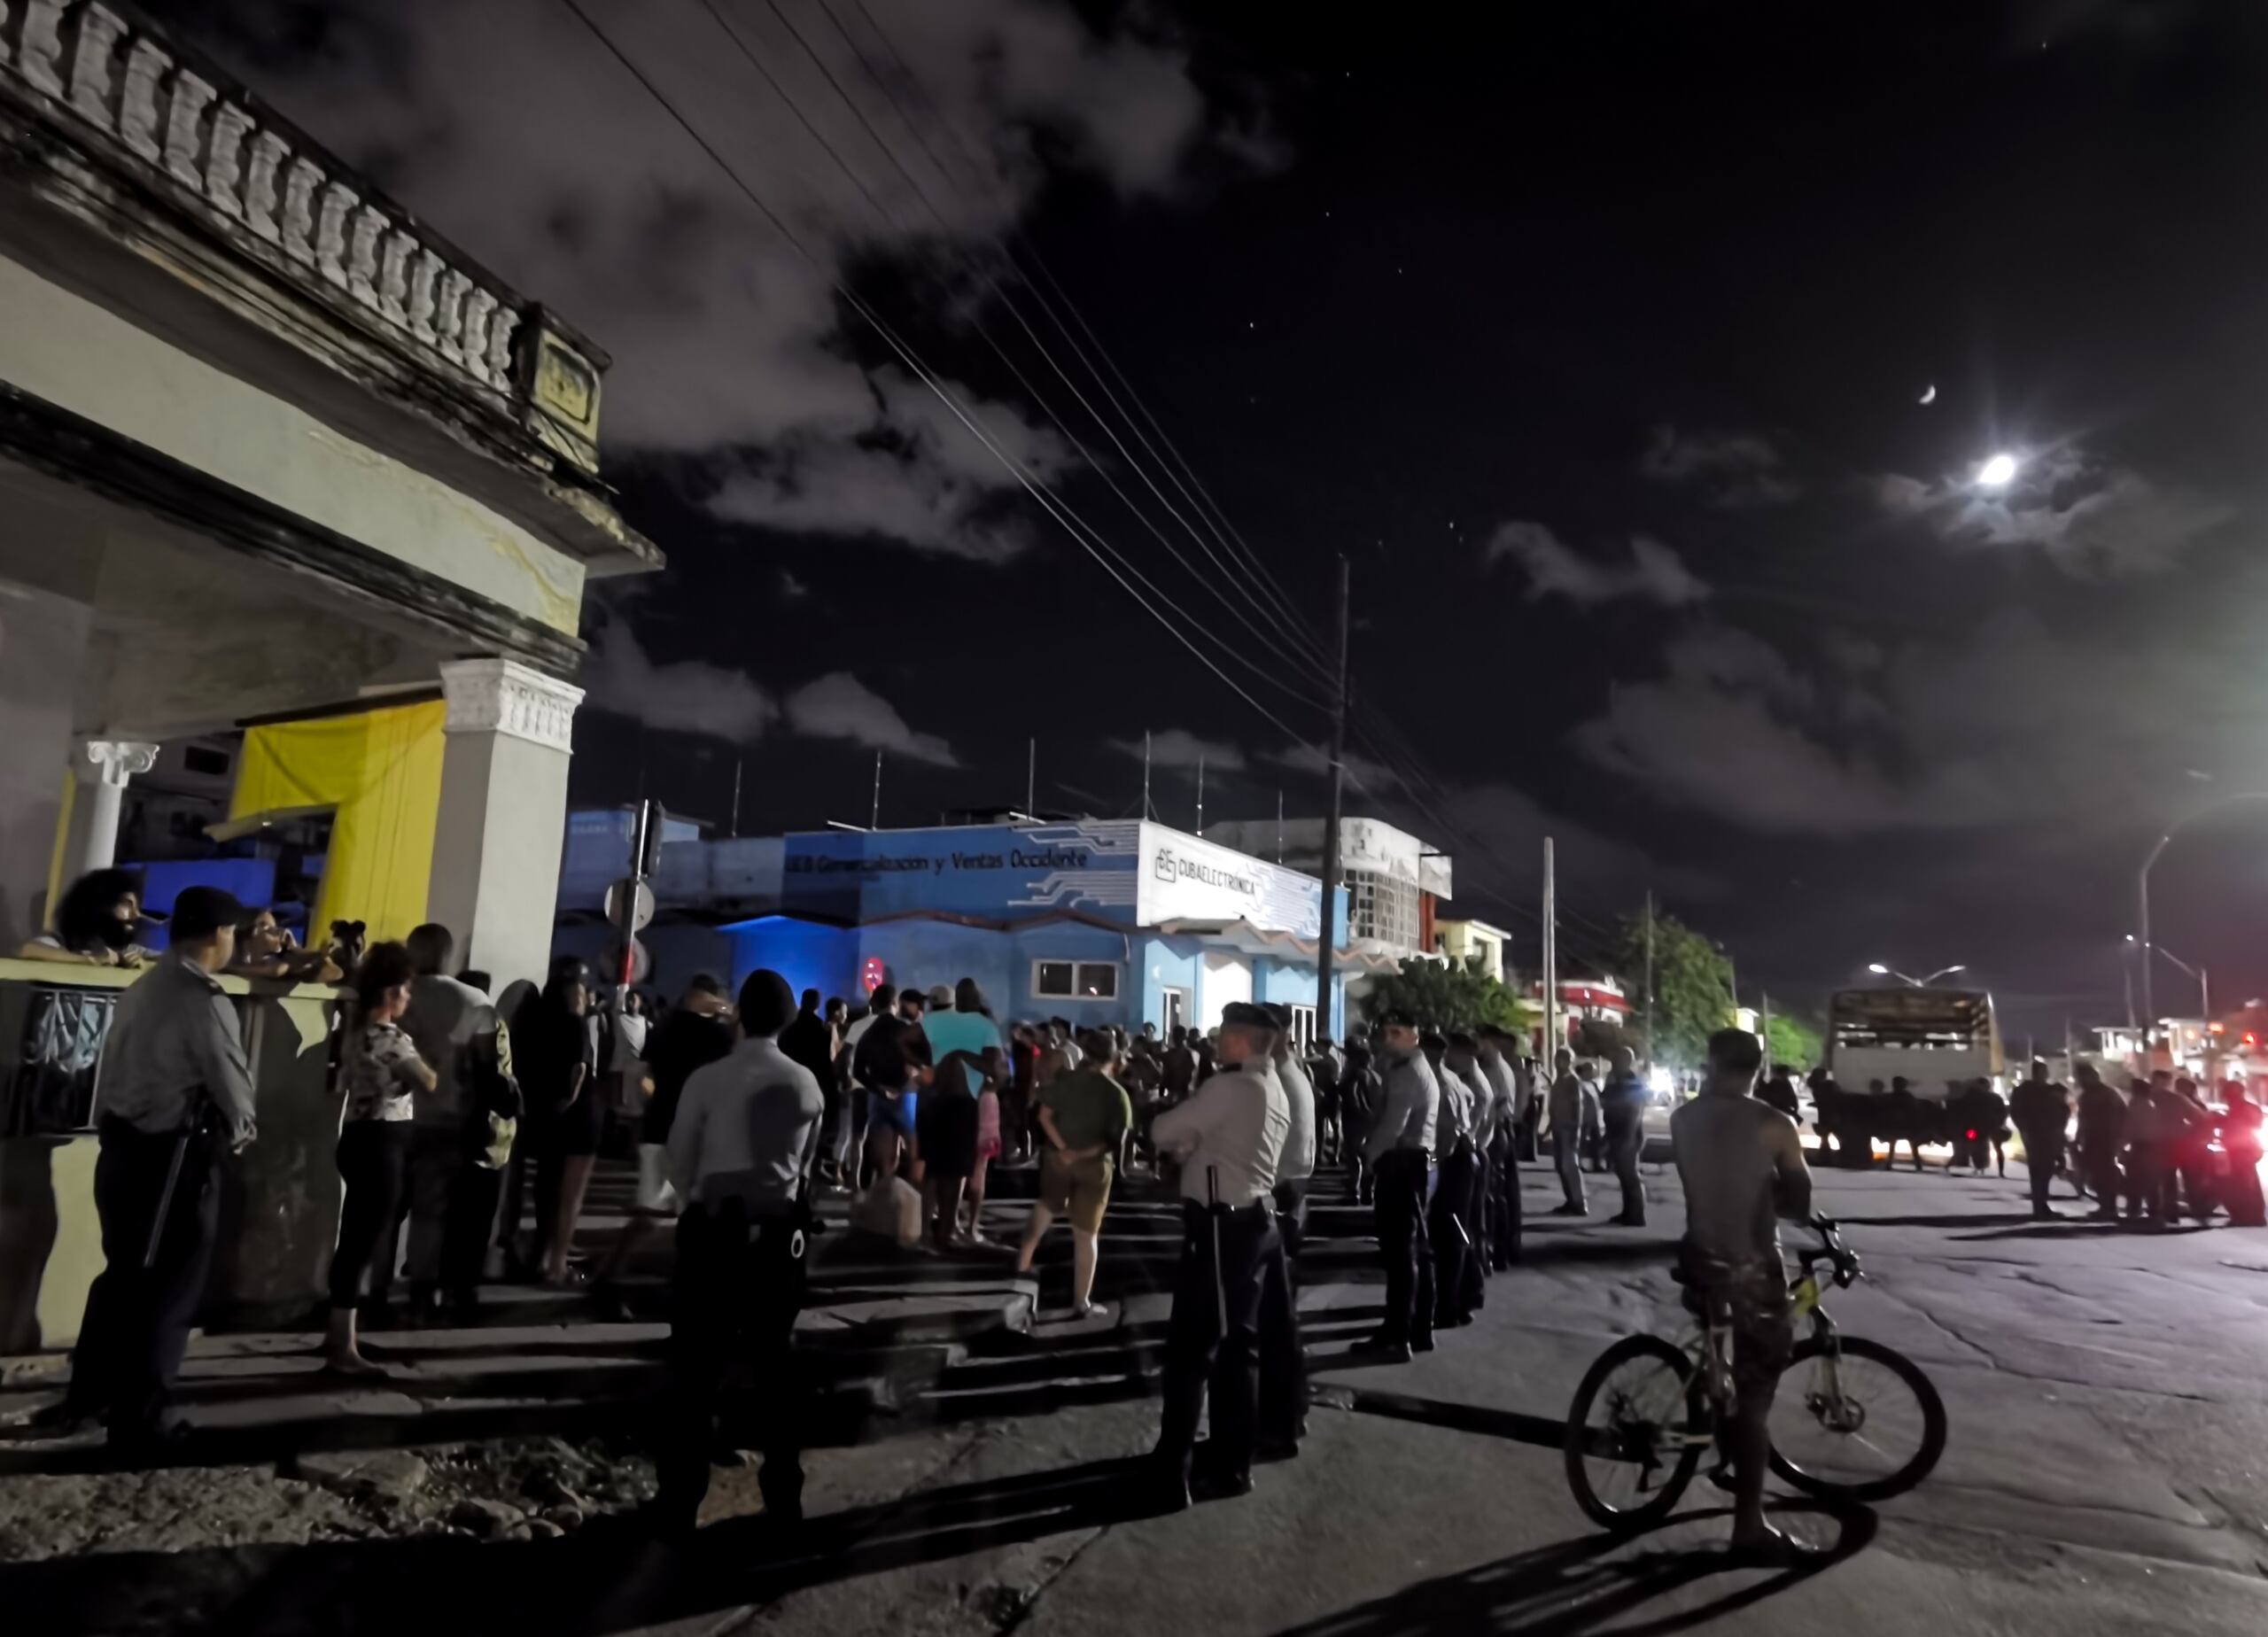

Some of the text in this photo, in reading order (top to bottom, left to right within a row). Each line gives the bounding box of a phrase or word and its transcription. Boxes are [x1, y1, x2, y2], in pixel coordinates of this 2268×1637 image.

[934, 857, 945, 874] y
[951, 852, 1003, 870] Ventas
[1010, 848, 1088, 869] Occidente
